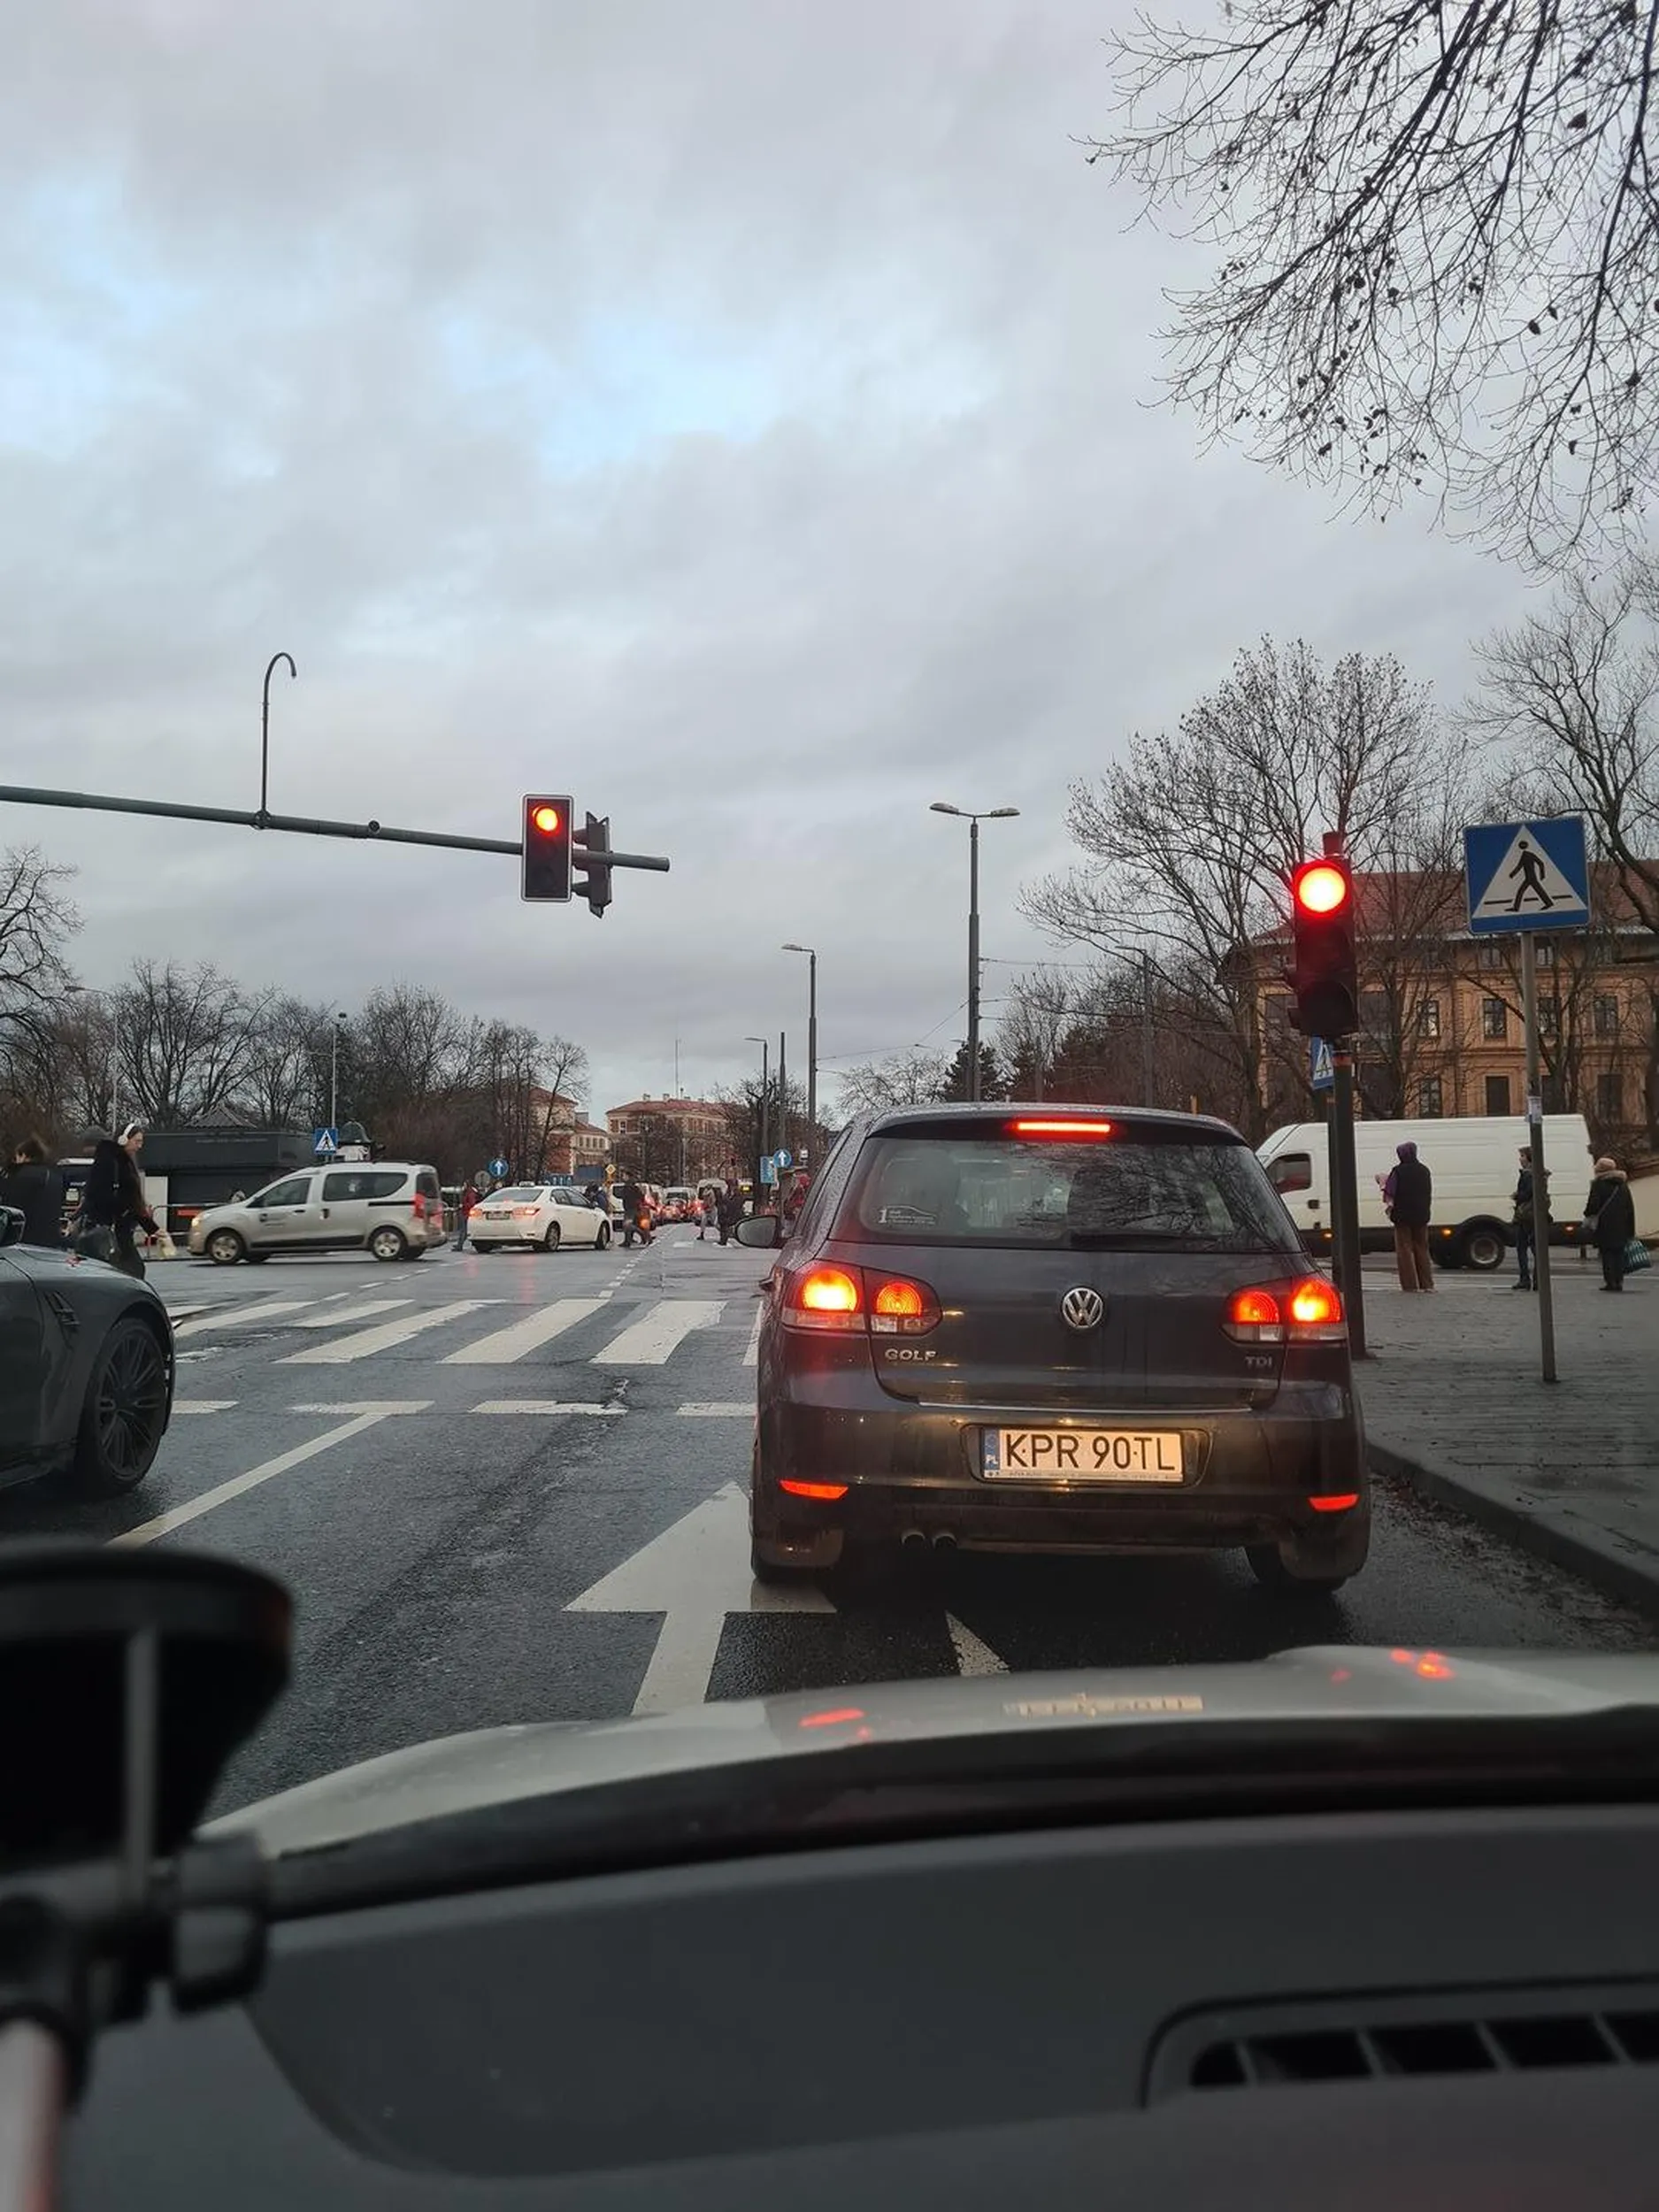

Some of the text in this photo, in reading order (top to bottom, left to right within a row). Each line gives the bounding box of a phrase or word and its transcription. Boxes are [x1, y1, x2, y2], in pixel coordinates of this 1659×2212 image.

[885, 1348, 936, 1361] GOLF
[1245, 1356, 1272, 1368] TDI
[1006, 1433, 1177, 1471] KPR 90TL
[986, 1454, 998, 1465] PL
